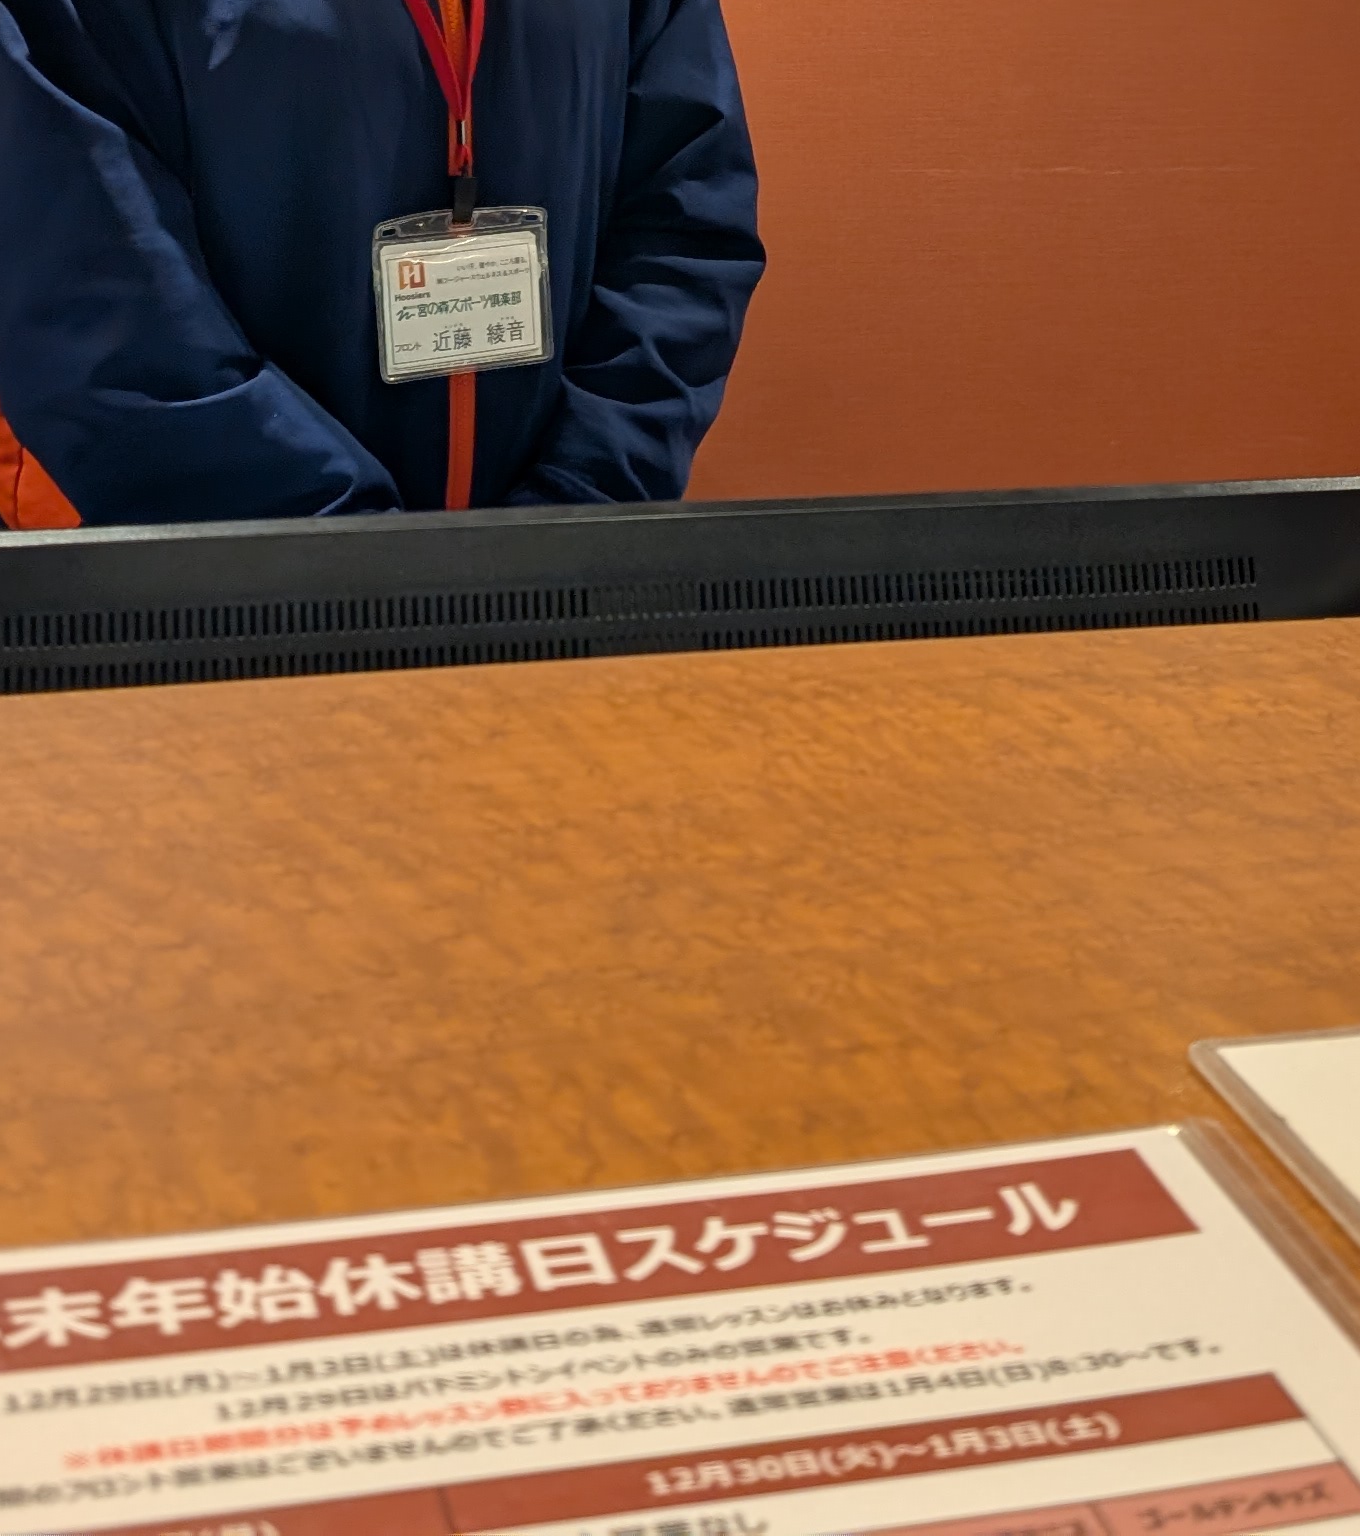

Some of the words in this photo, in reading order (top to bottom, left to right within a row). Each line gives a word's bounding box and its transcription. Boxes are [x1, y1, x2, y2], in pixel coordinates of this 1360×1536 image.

[394, 291, 431, 302] Hoosiers
[432, 328, 473, 352] 近藤
[486, 320, 525, 344] 綾音
